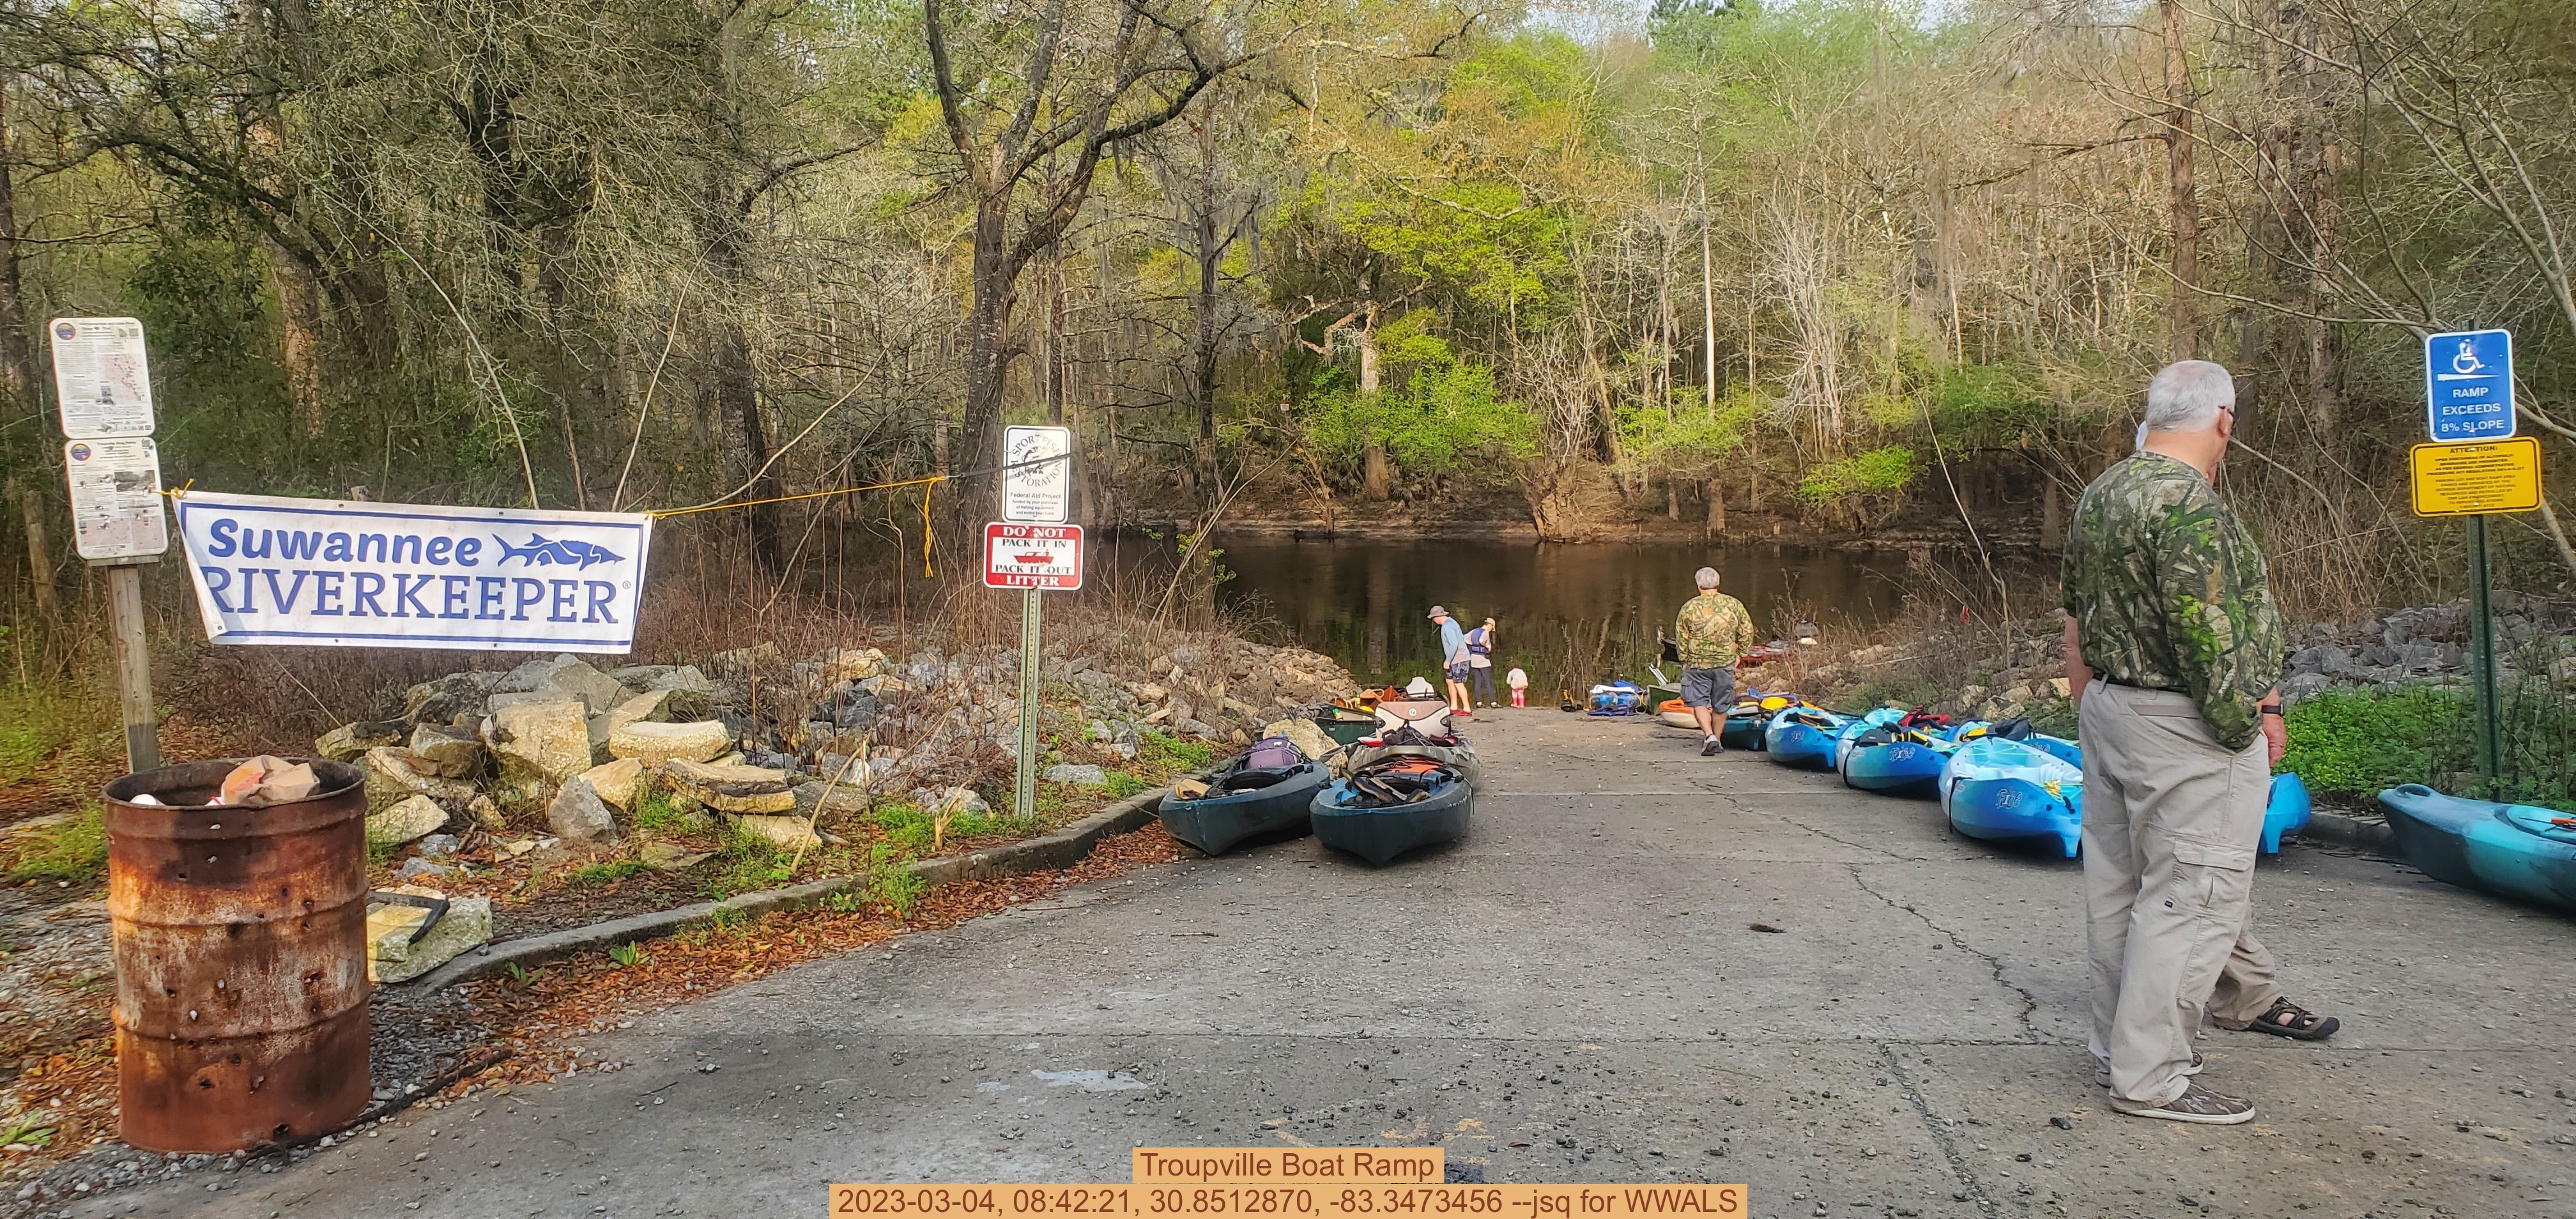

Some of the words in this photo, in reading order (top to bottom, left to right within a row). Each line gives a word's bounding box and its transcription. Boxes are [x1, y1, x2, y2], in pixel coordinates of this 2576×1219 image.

[2453, 387, 2488, 398] RAMP
[2442, 403, 2501, 415] EXCEEDS
[2441, 422, 2460, 432] 8%
[2463, 420, 2505, 431] SLOPE
[1003, 526, 1028, 537] DO
[1033, 528, 1066, 539] NOT
[208, 518, 483, 567] Suwannee
[1002, 538, 1031, 548] PACK
[1037, 539, 1049, 548] IT
[1054, 540, 1067, 549] IN
[995, 564, 1024, 573] PACK
[1030, 565, 1040, 574] IT
[1047, 565, 1072, 574] OUT
[1006, 575, 1060, 586] LITTER
